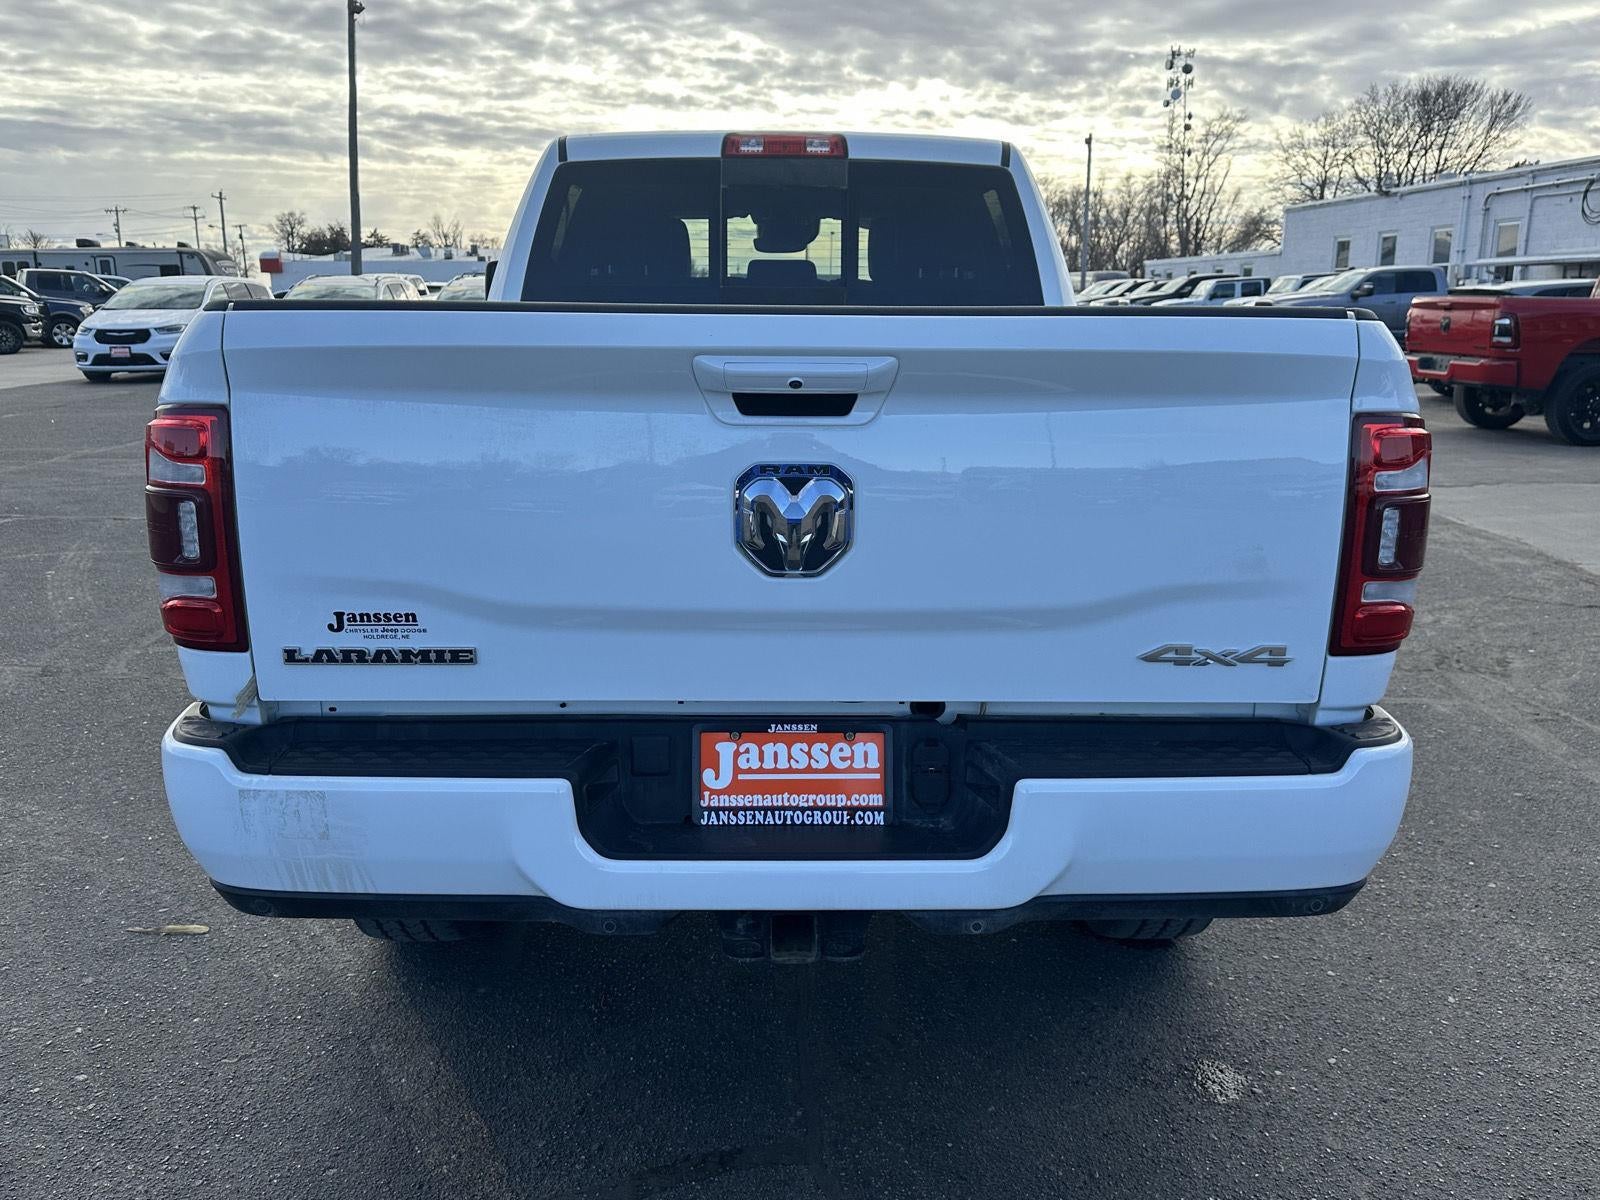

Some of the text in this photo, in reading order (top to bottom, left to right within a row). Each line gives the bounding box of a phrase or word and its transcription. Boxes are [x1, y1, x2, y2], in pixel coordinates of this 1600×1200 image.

[759, 465, 830, 475] RAM
[327, 611, 418, 632] Janssen
[284, 646, 477, 665] LARAMIE
[768, 724, 818, 733] JANSSEN
[702, 741, 881, 790] Janssen
[700, 791, 883, 807] Janssenautogroup.com
